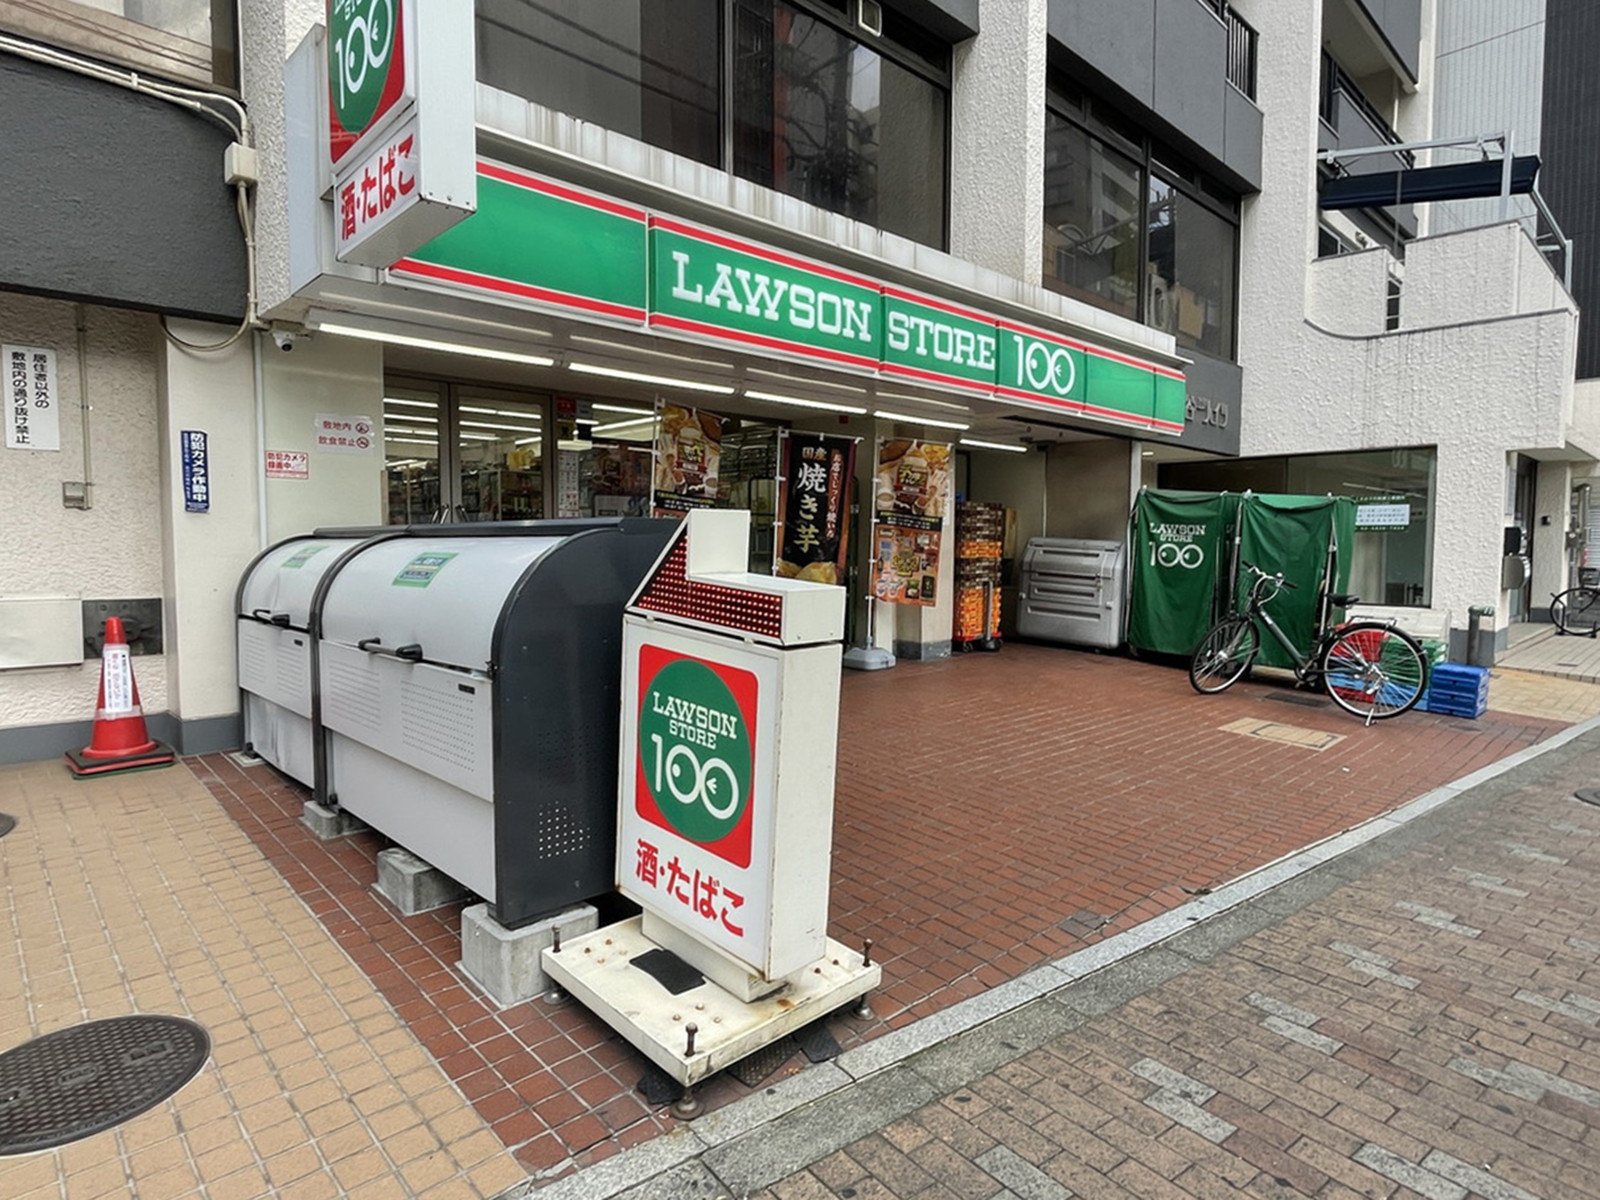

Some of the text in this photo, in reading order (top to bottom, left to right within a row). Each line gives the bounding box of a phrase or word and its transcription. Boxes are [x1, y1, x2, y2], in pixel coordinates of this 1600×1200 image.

[340, 133, 416, 241] 酒・たばこ
[671, 250, 1076, 396] LAWSON STORE 100
[11, 351, 31, 445] 敷地内の通り抜け禁止
[33, 353, 50, 409] 居住者以外の
[318, 435, 356, 447] 飲食禁止
[322, 420, 352, 431] 敷地内
[190, 432, 207, 502] 防犯カメラ作動中
[267, 452, 307, 463] 防犯カメラ
[802, 446, 828, 461] 国産
[793, 462, 828, 553] 焼き芋
[1149, 522, 1207, 536] LAWSON
[1148, 541, 1205, 569] 100
[1159, 533, 1194, 543] STORE
[652, 690, 739, 741] LAWSON
[668, 719, 718, 750] STORE
[651, 732, 740, 821] 100
[635, 837, 746, 939] 酒・たばこ
